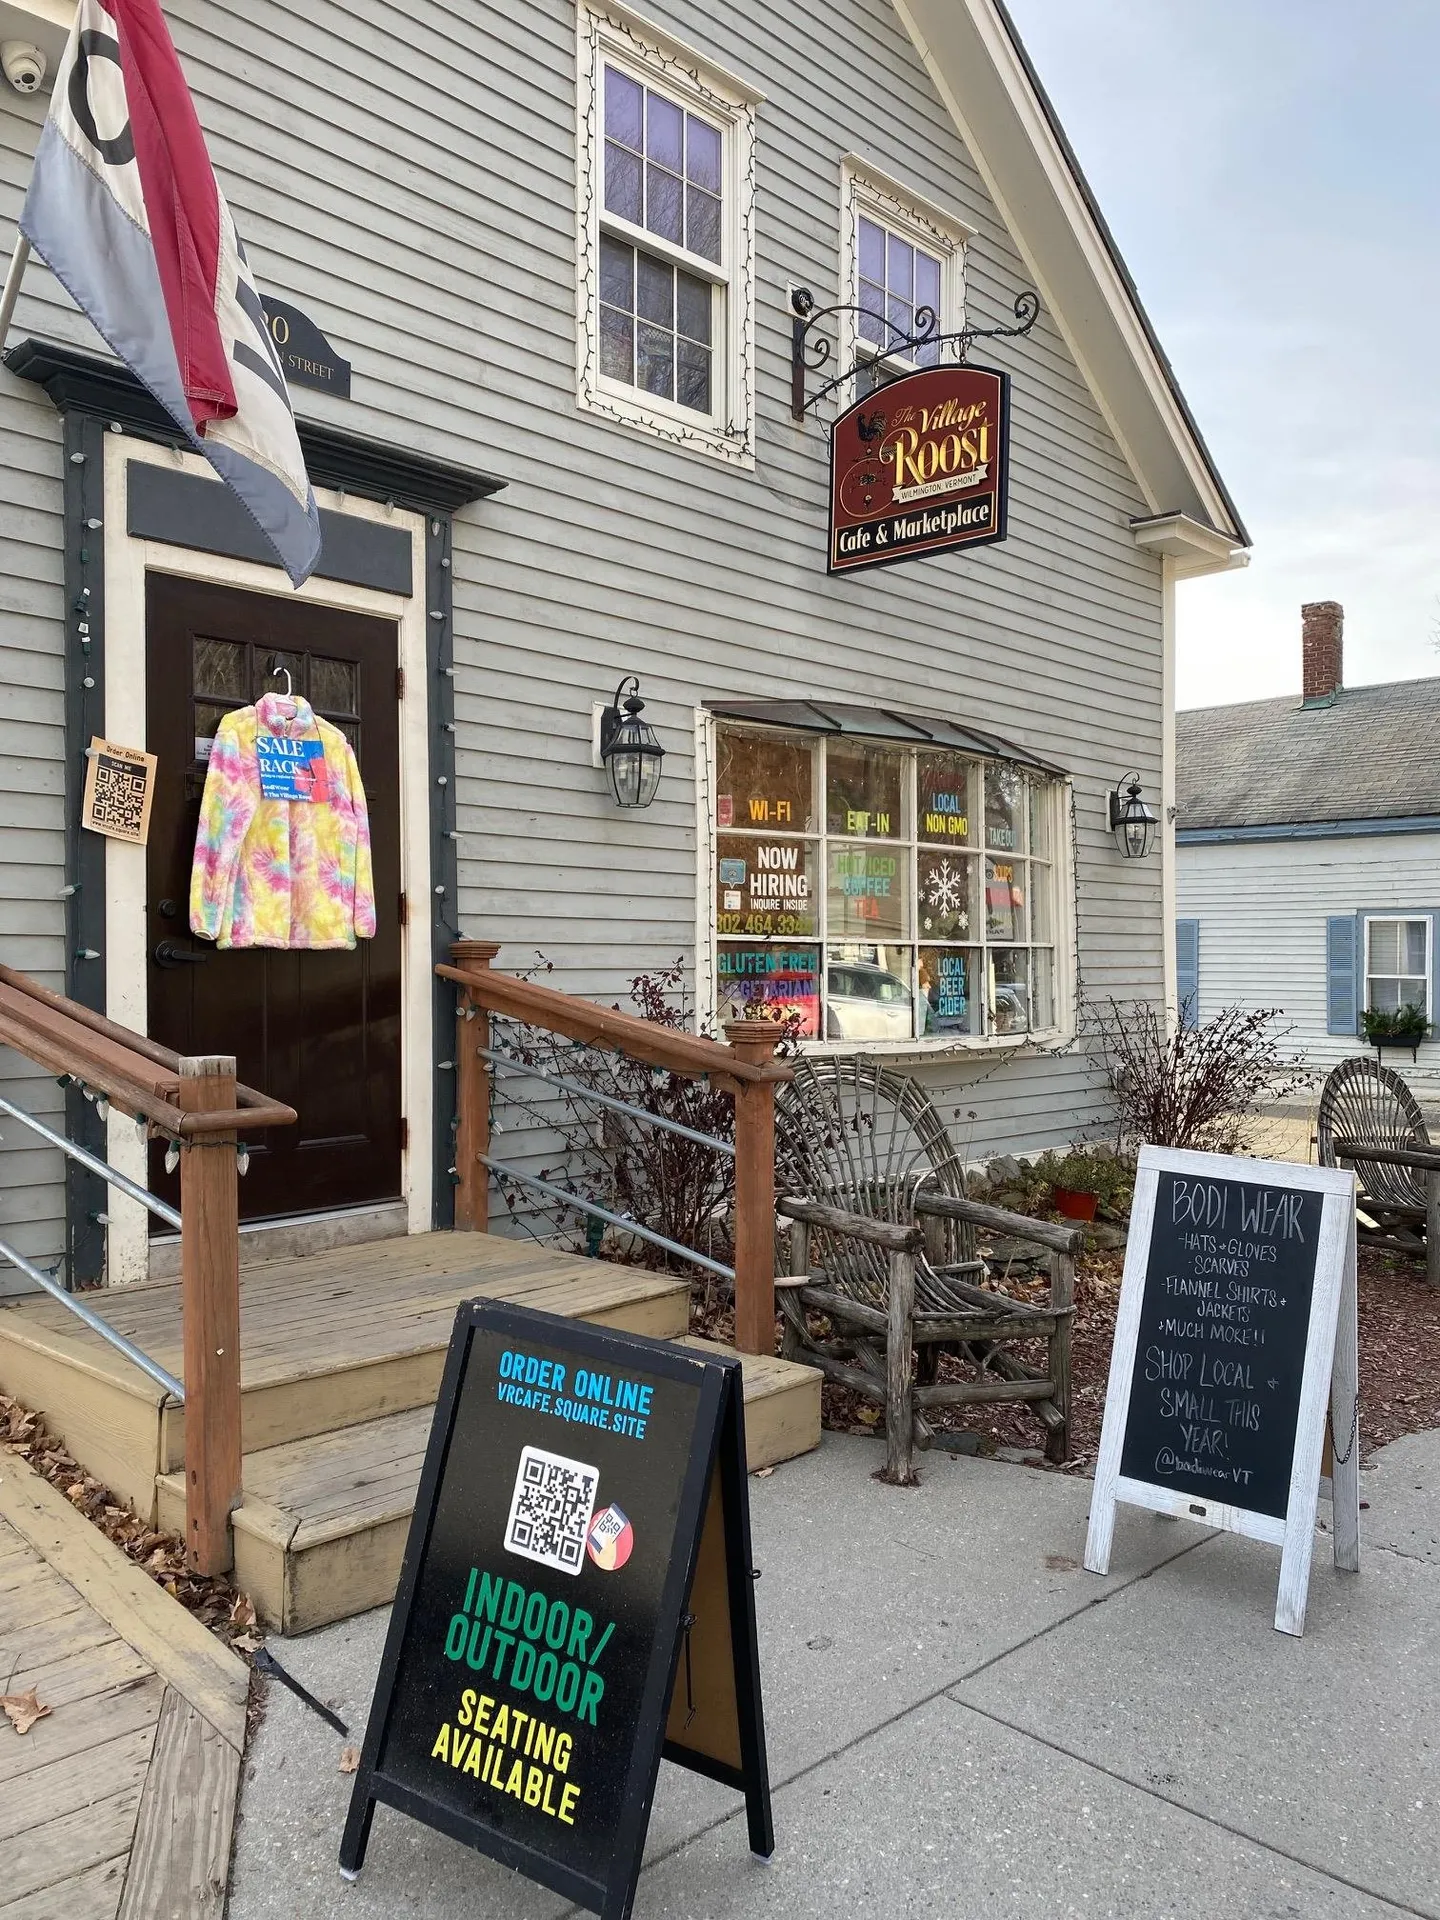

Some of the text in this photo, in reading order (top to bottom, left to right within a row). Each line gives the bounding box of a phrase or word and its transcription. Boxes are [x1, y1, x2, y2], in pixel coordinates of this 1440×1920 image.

[288, 354, 334, 380] STREET
[891, 398, 987, 434] The Village
[945, 475, 977, 490] VERMONT
[840, 504, 989, 552] Cafe & Marketplace
[106, 745, 145, 762] Order Online
[256, 736, 305, 757] SALE
[111, 761, 132, 772] SCAN ME
[260, 758, 301, 774] RACK
[749, 799, 791, 821] WI-FI
[932, 793, 961, 813] LOCAL
[847, 811, 890, 832] EAT-IN
[926, 814, 969, 836] NON GMO
[757, 846, 798, 869] NOW
[750, 873, 808, 897] HIRING
[843, 877, 891, 897] COFFEE
[750, 898, 808, 911] INQUIRE INSIDE
[854, 897, 880, 919] TEA
[717, 952, 818, 974] GLUTEN FREE
[937, 957, 966, 976] LOCAL
[940, 977, 965, 996] BEER
[939, 996, 967, 1015] CIDER
[1172, 1180, 1305, 1243] BODI WEAR
[1227, 1238, 1277, 1263] GLOVES
[1226, 1281, 1278, 1308] SHIRTS
[1196, 1300, 1250, 1323] JACKETS
[1165, 1318, 1204, 1339] MUCH
[1210, 1323, 1266, 1346] MORE!!
[1145, 1345, 1193, 1381] SHOP
[1200, 1353, 1254, 1389] LOCAL
[499, 1350, 654, 1416] ORDER ONLINE
[497, 1382, 647, 1440] VRCAFE.SQUARE.SITE
[1160, 1387, 1260, 1431] SMALL THIS
[1180, 1423, 1230, 1461] YEAR!
[462, 1567, 616, 1666] INDOOR/
[444, 1613, 604, 1726] OUTDOOR
[457, 1689, 572, 1774] SEATING
[431, 1723, 581, 1825] AVAILABLE
